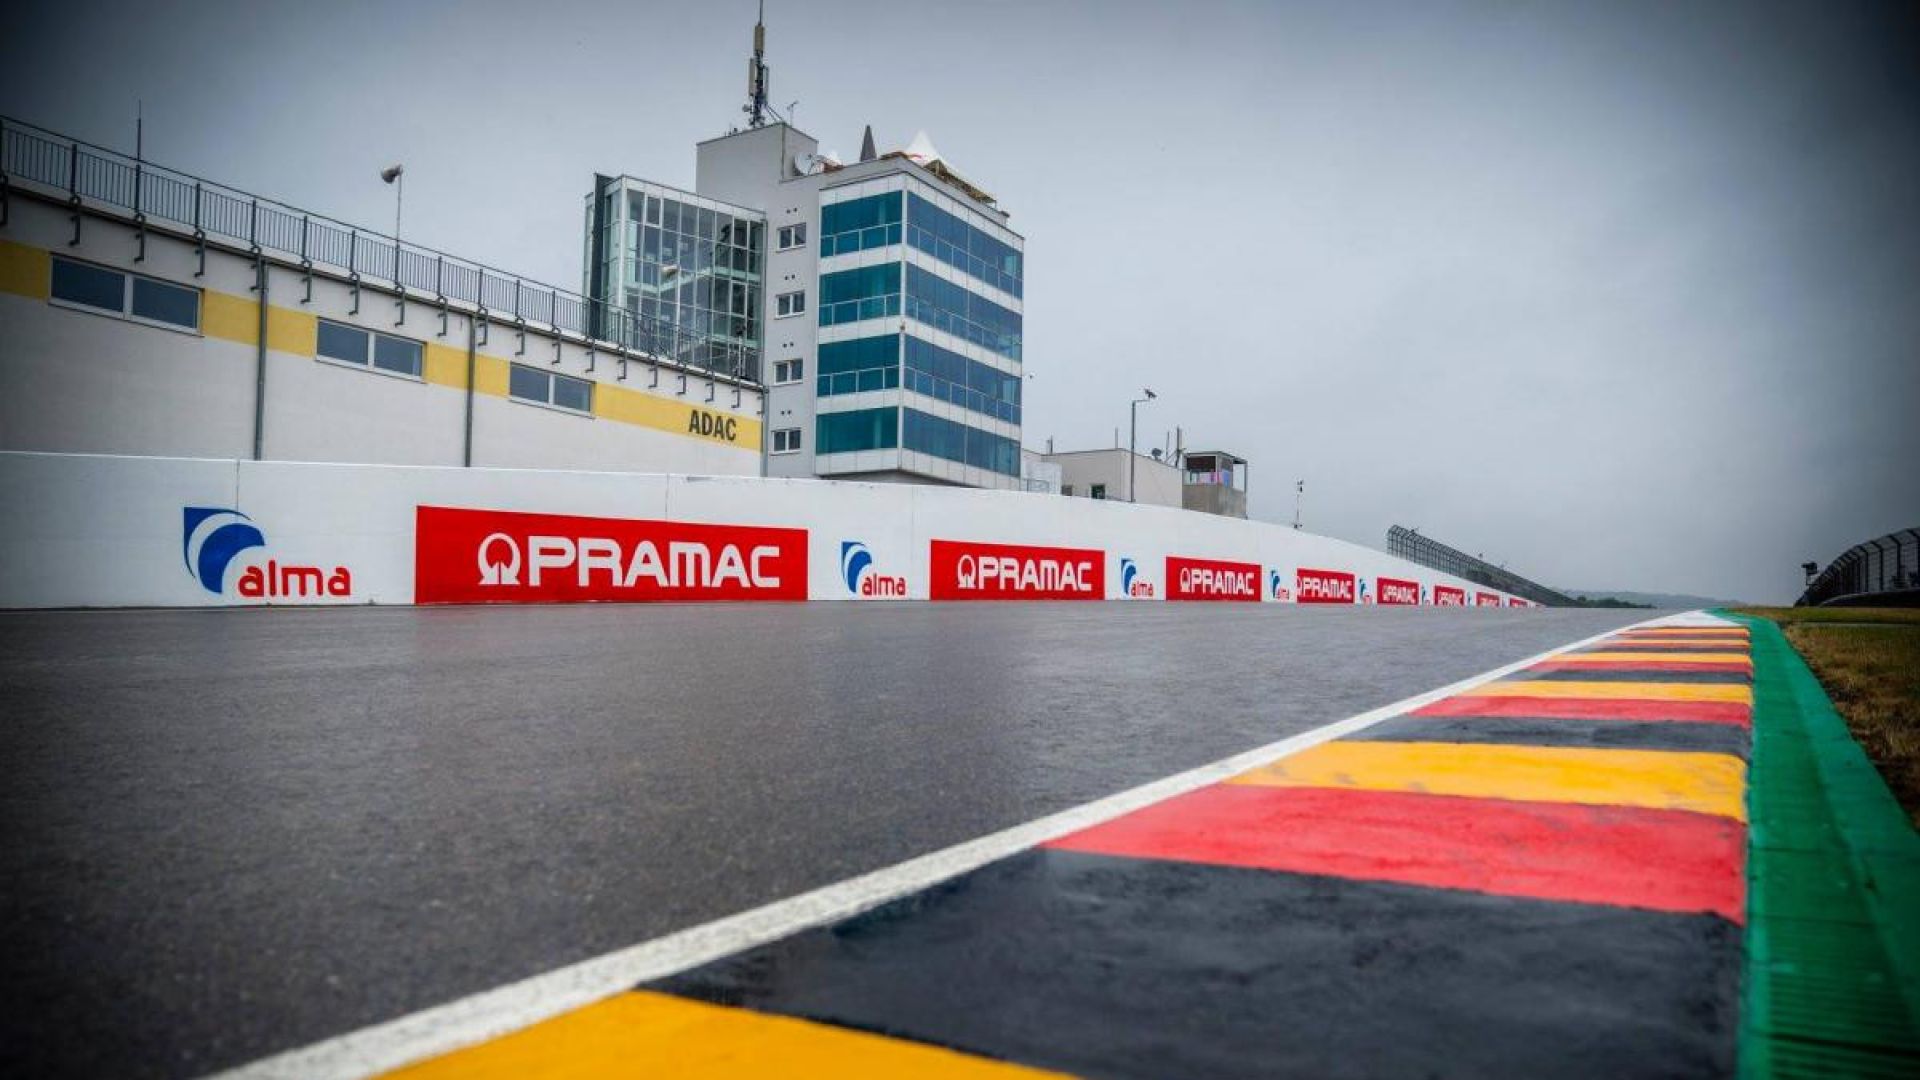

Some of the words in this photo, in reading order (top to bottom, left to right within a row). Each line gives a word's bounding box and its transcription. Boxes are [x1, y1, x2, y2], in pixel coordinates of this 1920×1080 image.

[689, 409, 737, 442] ADAC
[238, 560, 351, 597] alma
[529, 536, 780, 588] PRAMAC
[978, 557, 1092, 591] PRAMAC
[862, 573, 906, 596] alma
[1131, 580, 1154, 597] alma
[1190, 569, 1254, 595] PRAMAC
